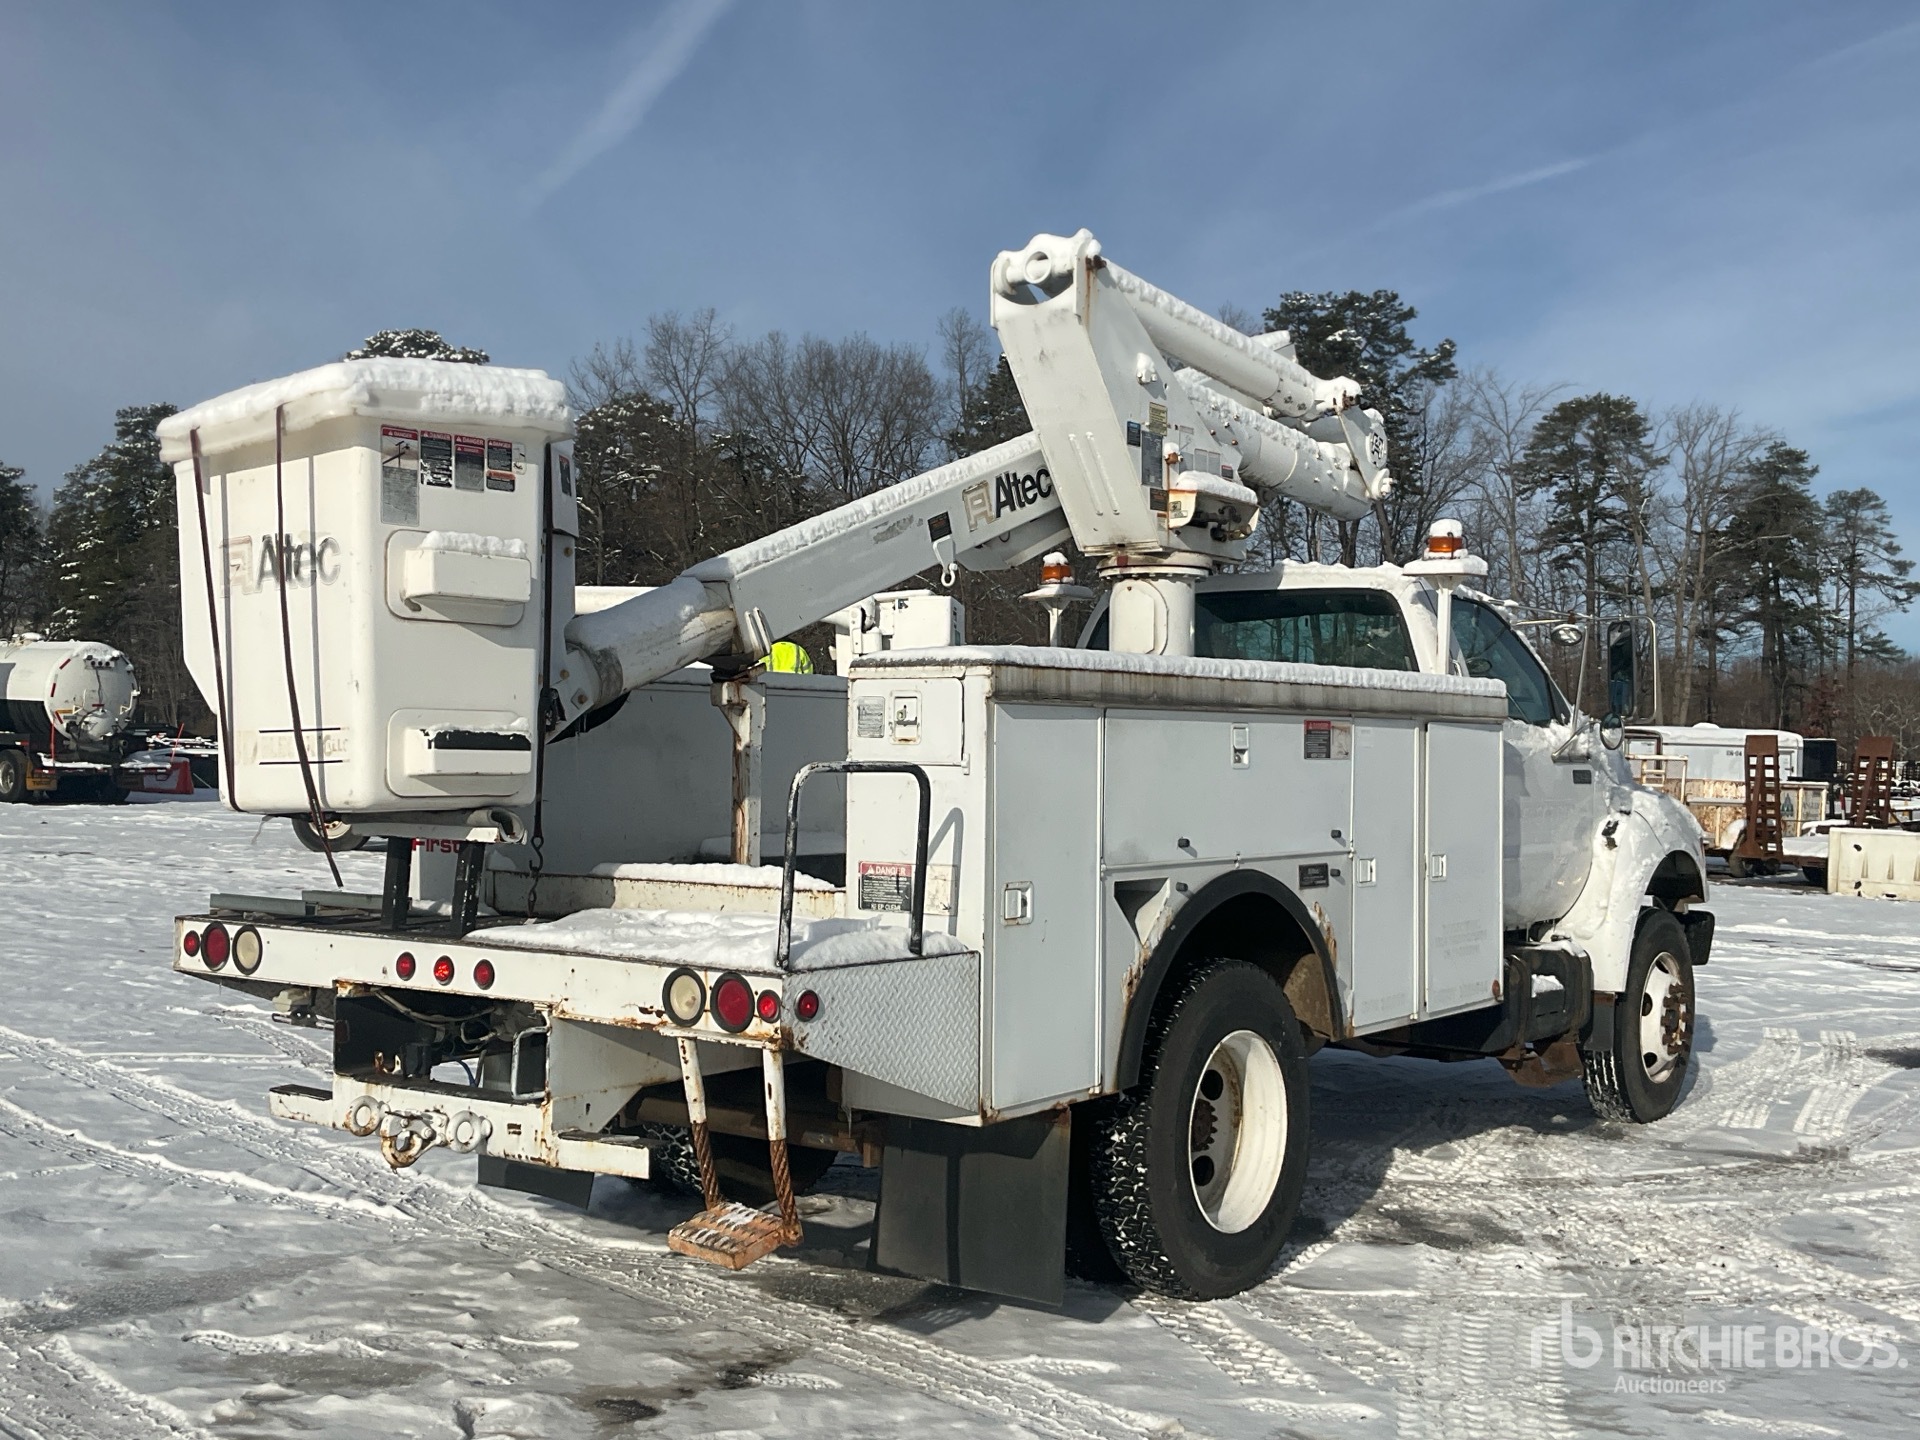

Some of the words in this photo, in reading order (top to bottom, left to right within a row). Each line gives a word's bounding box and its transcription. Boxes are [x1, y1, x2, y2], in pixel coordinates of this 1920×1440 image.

[462, 436, 484, 446] DANGER
[995, 468, 1052, 518] Altec
[875, 866, 906, 876] DANGER
